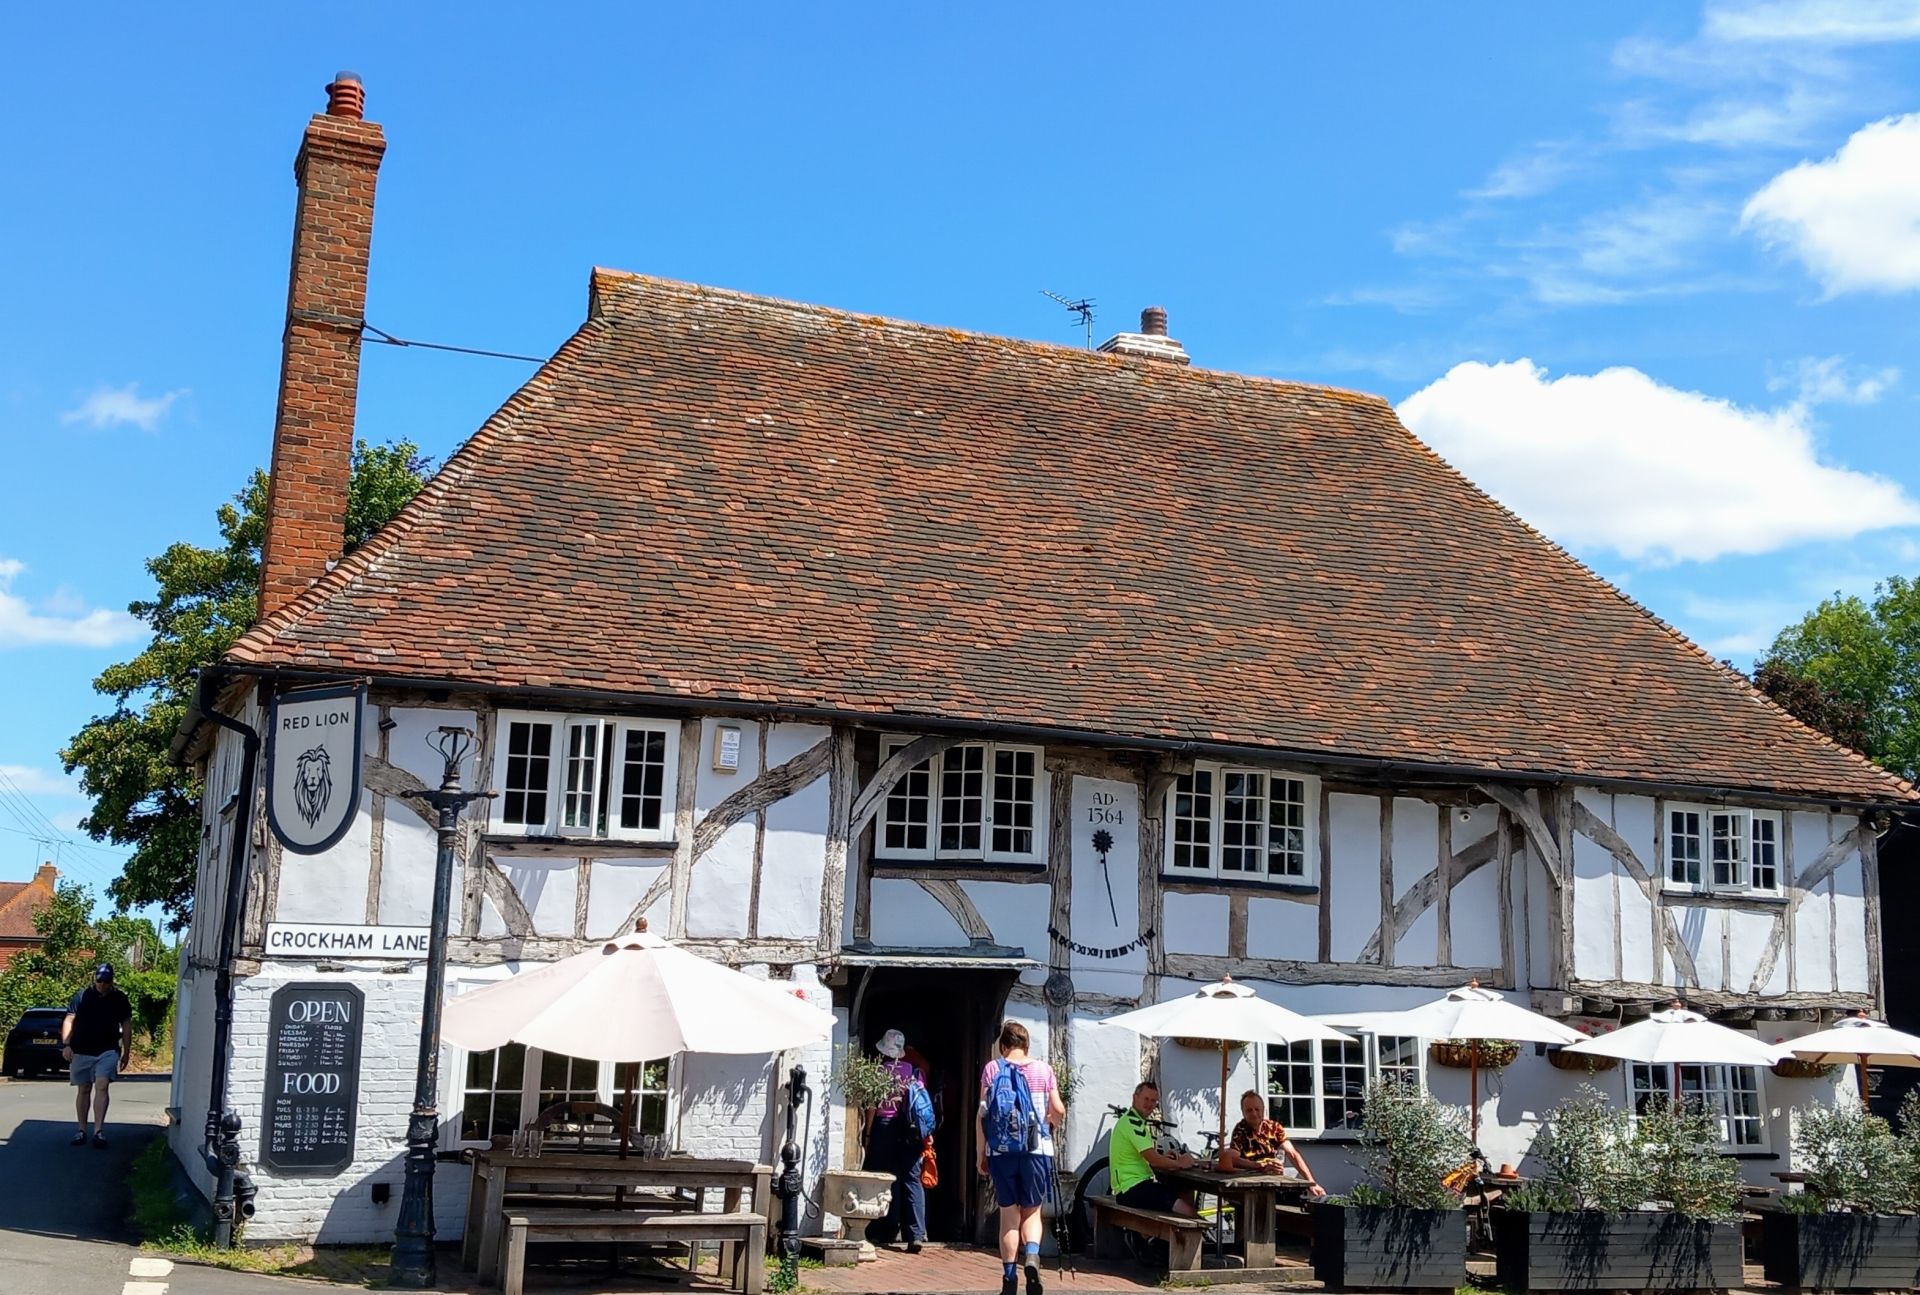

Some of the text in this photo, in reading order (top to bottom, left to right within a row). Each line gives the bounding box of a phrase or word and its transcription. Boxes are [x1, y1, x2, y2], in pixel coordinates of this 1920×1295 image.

[283, 712, 349, 730] RED LION
[271, 931, 428, 951] CROCKHAM LANE
[289, 1001, 351, 1023] OPEN
[283, 1073, 340, 1094] FOOD
[272, 1144, 286, 1152] SUN
